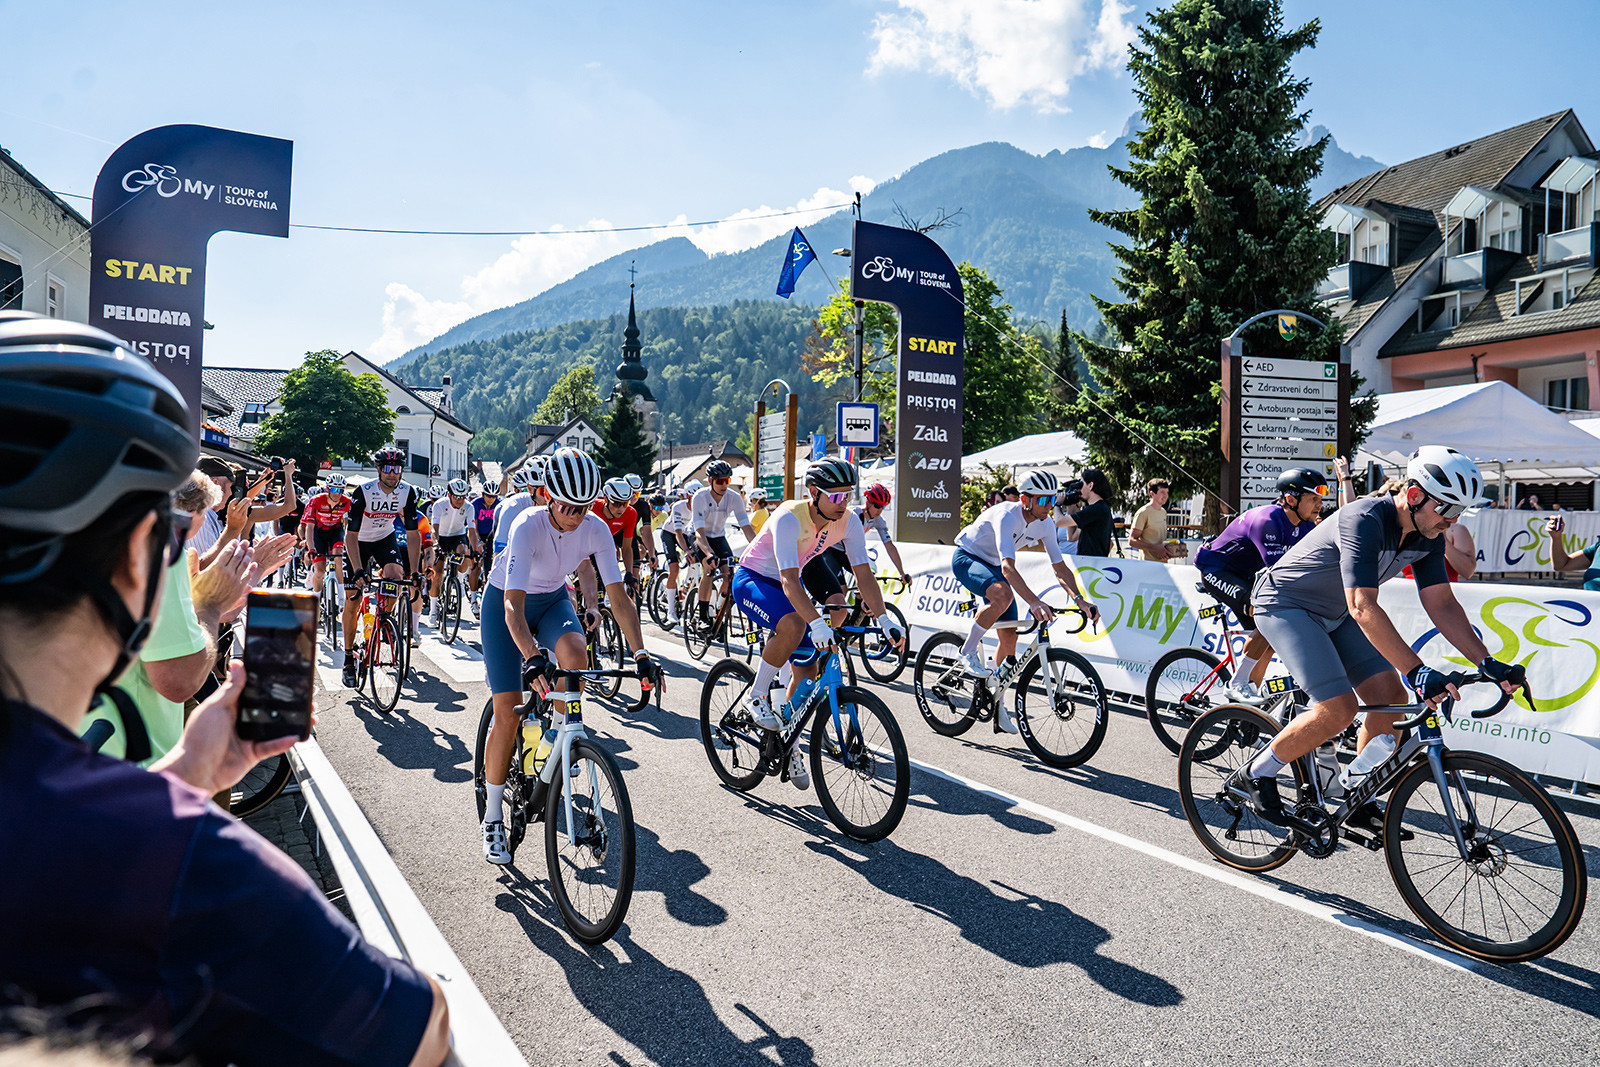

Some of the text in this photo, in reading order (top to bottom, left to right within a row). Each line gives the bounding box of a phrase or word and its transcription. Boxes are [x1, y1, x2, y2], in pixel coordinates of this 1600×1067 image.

[184, 178, 268, 200] My TOUR of
[224, 195, 278, 211] SLOVENIA
[105, 258, 192, 285] START
[896, 266, 914, 283] My
[920, 270, 937, 279] TOUR
[920, 278, 951, 289] SLOVENIA
[103, 304, 191, 327] PELODATA
[908, 337, 957, 355] START
[1255, 362, 1274, 372] AED
[907, 370, 957, 386] PELODATA
[1257, 383, 1320, 394] Zdravstveni dom
[1257, 404, 1321, 417] Avtobusna postaja
[912, 424, 948, 443] Zala
[1257, 423, 1287, 433] Lekarna
[1256, 443, 1299, 455] Informacije
[914, 457, 952, 471] A2U
[1255, 463, 1283, 473] Občina
[910, 486, 949, 499] VitalGo
[370, 501, 399, 512] UAE
[930, 511, 952, 519] MESTO
[814, 530, 829, 553] RYSEL
[385, 583, 396, 591] 127
[924, 574, 963, 595] TOUR
[1203, 572, 1241, 599] BRANIK
[743, 597, 771, 624] VAN RYSEL
[1199, 607, 1217, 618] 104
[1126, 594, 1190, 645] My
[747, 633, 757, 644] 58
[1268, 679, 1286, 693] 55
